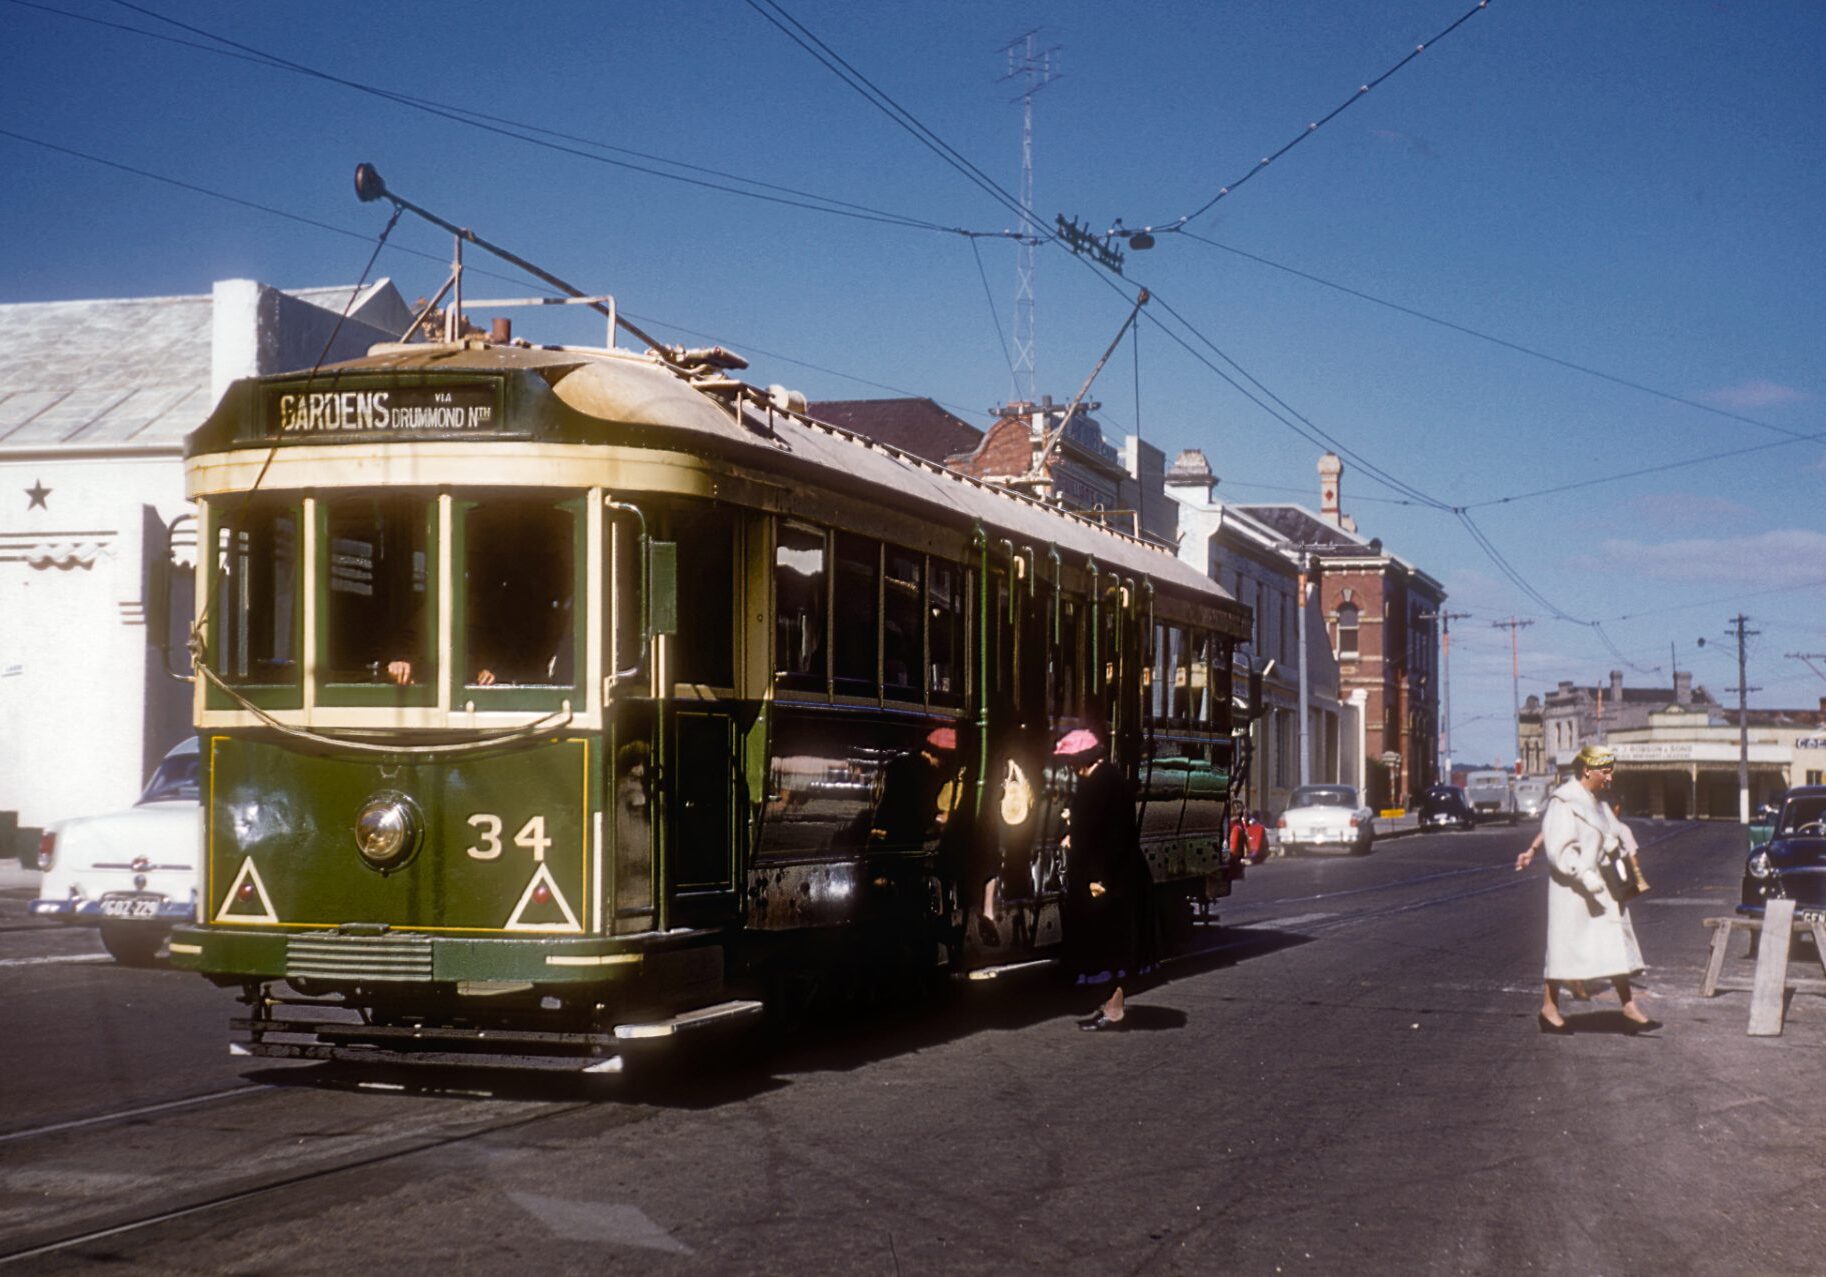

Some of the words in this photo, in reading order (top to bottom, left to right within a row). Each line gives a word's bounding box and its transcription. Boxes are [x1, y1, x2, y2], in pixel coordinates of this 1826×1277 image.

[280, 392, 389, 431] GARDENS
[434, 393, 452, 402] VIA
[392, 407, 464, 429] DRUMMOND
[467, 813, 552, 862] 34
